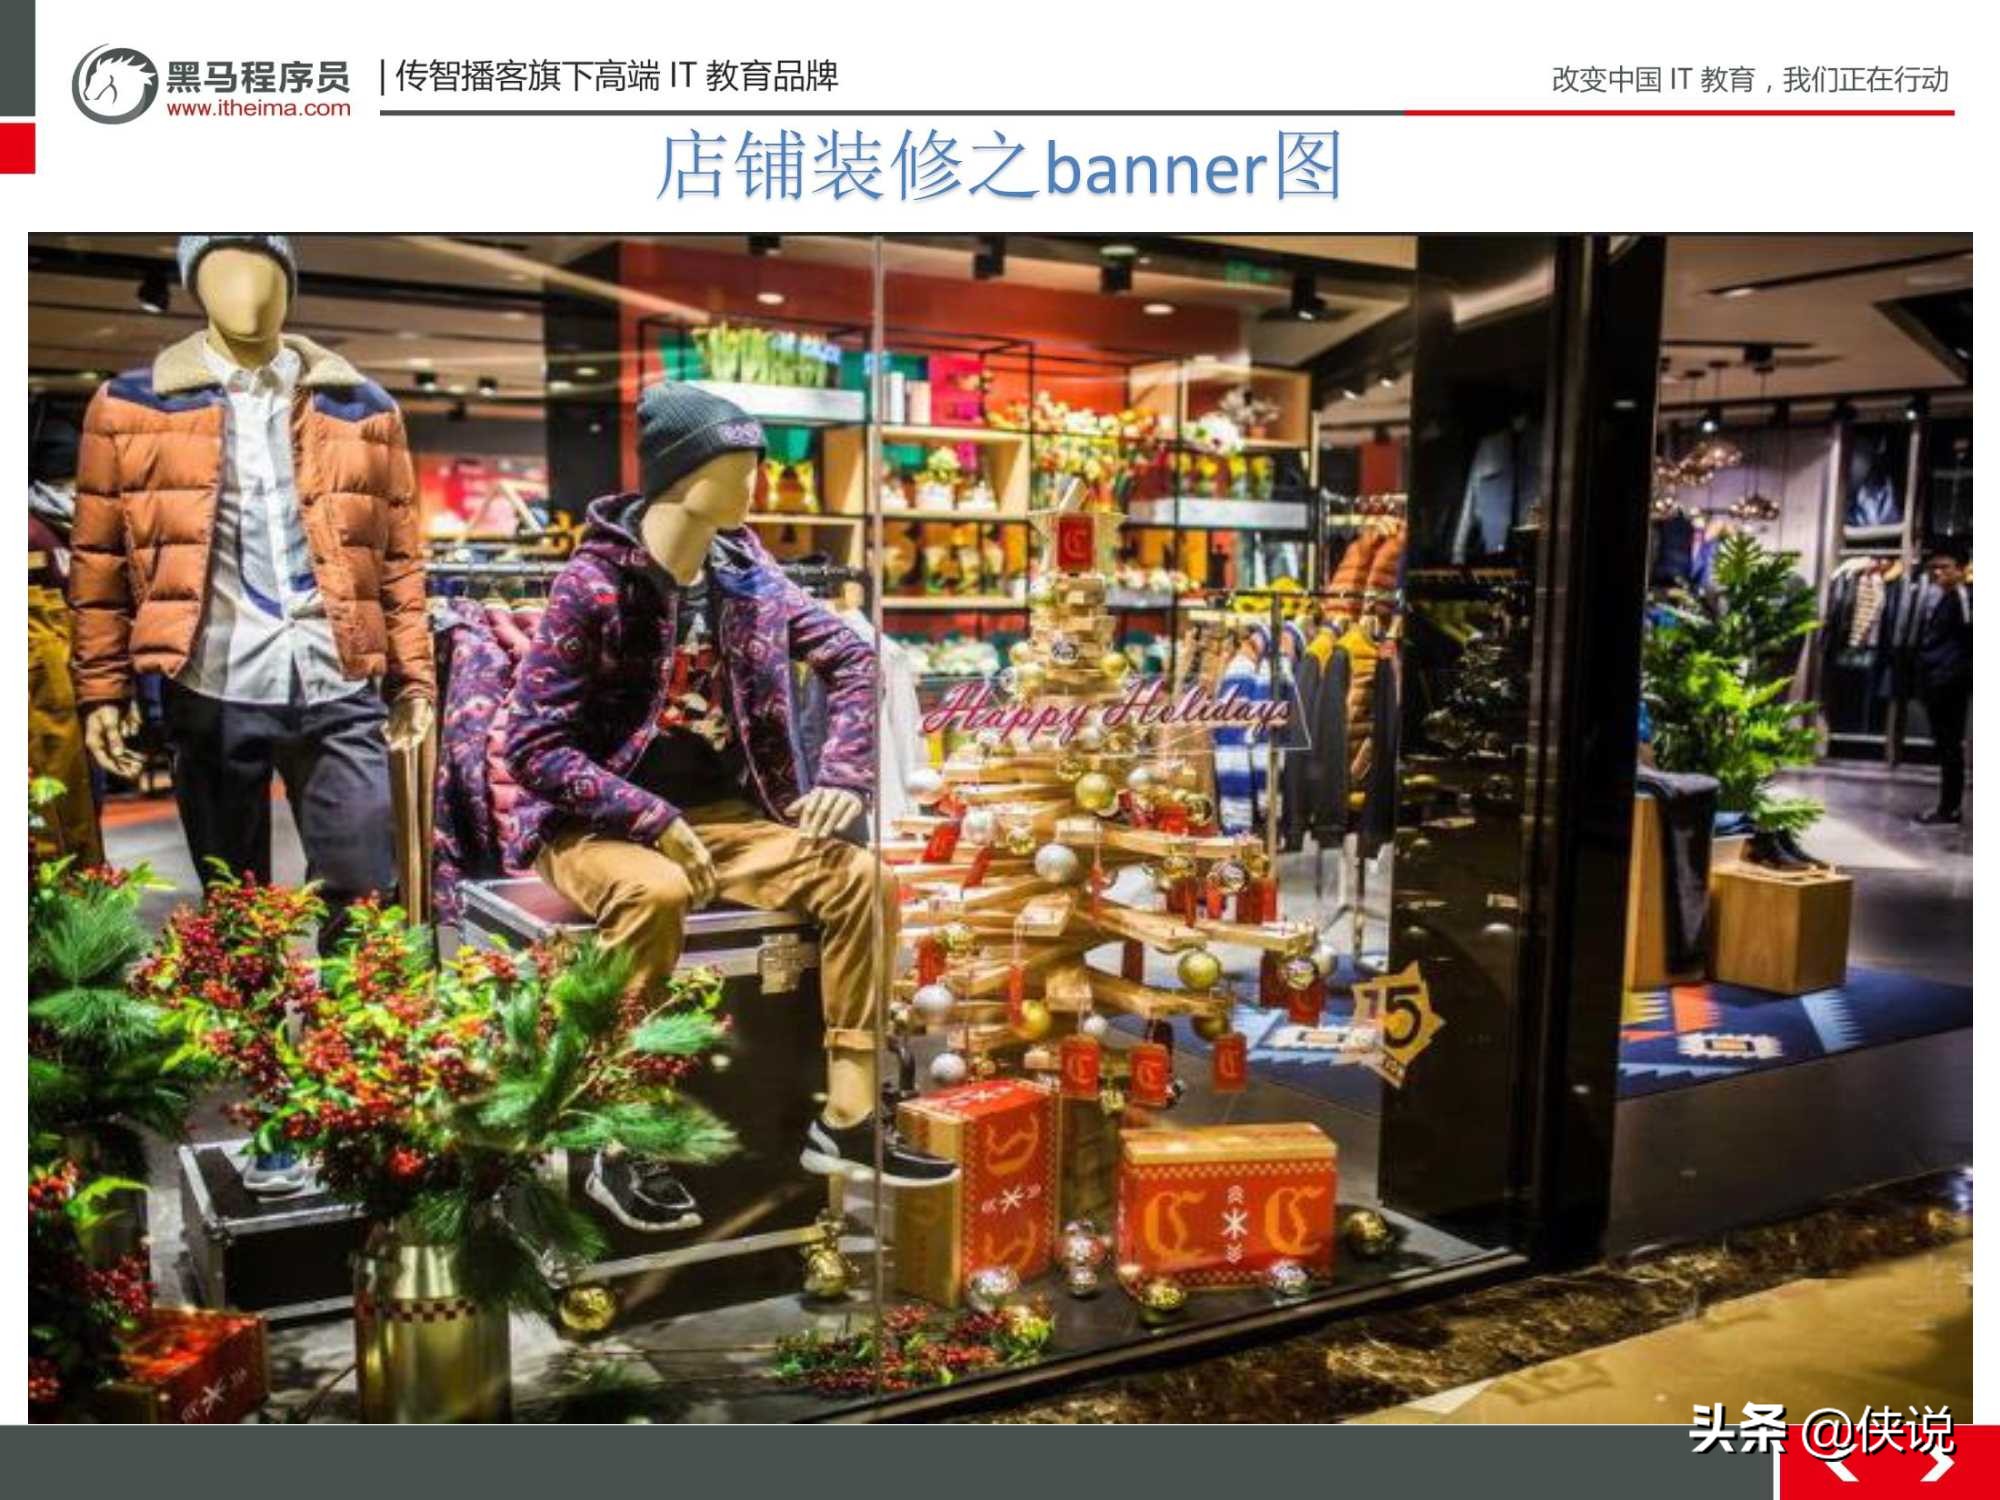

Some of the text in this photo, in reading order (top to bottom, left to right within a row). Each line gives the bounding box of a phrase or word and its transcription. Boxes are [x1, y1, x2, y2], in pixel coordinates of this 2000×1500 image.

[922, 678, 1294, 746] Happy Holidays
[1361, 985, 1421, 1049] 15
